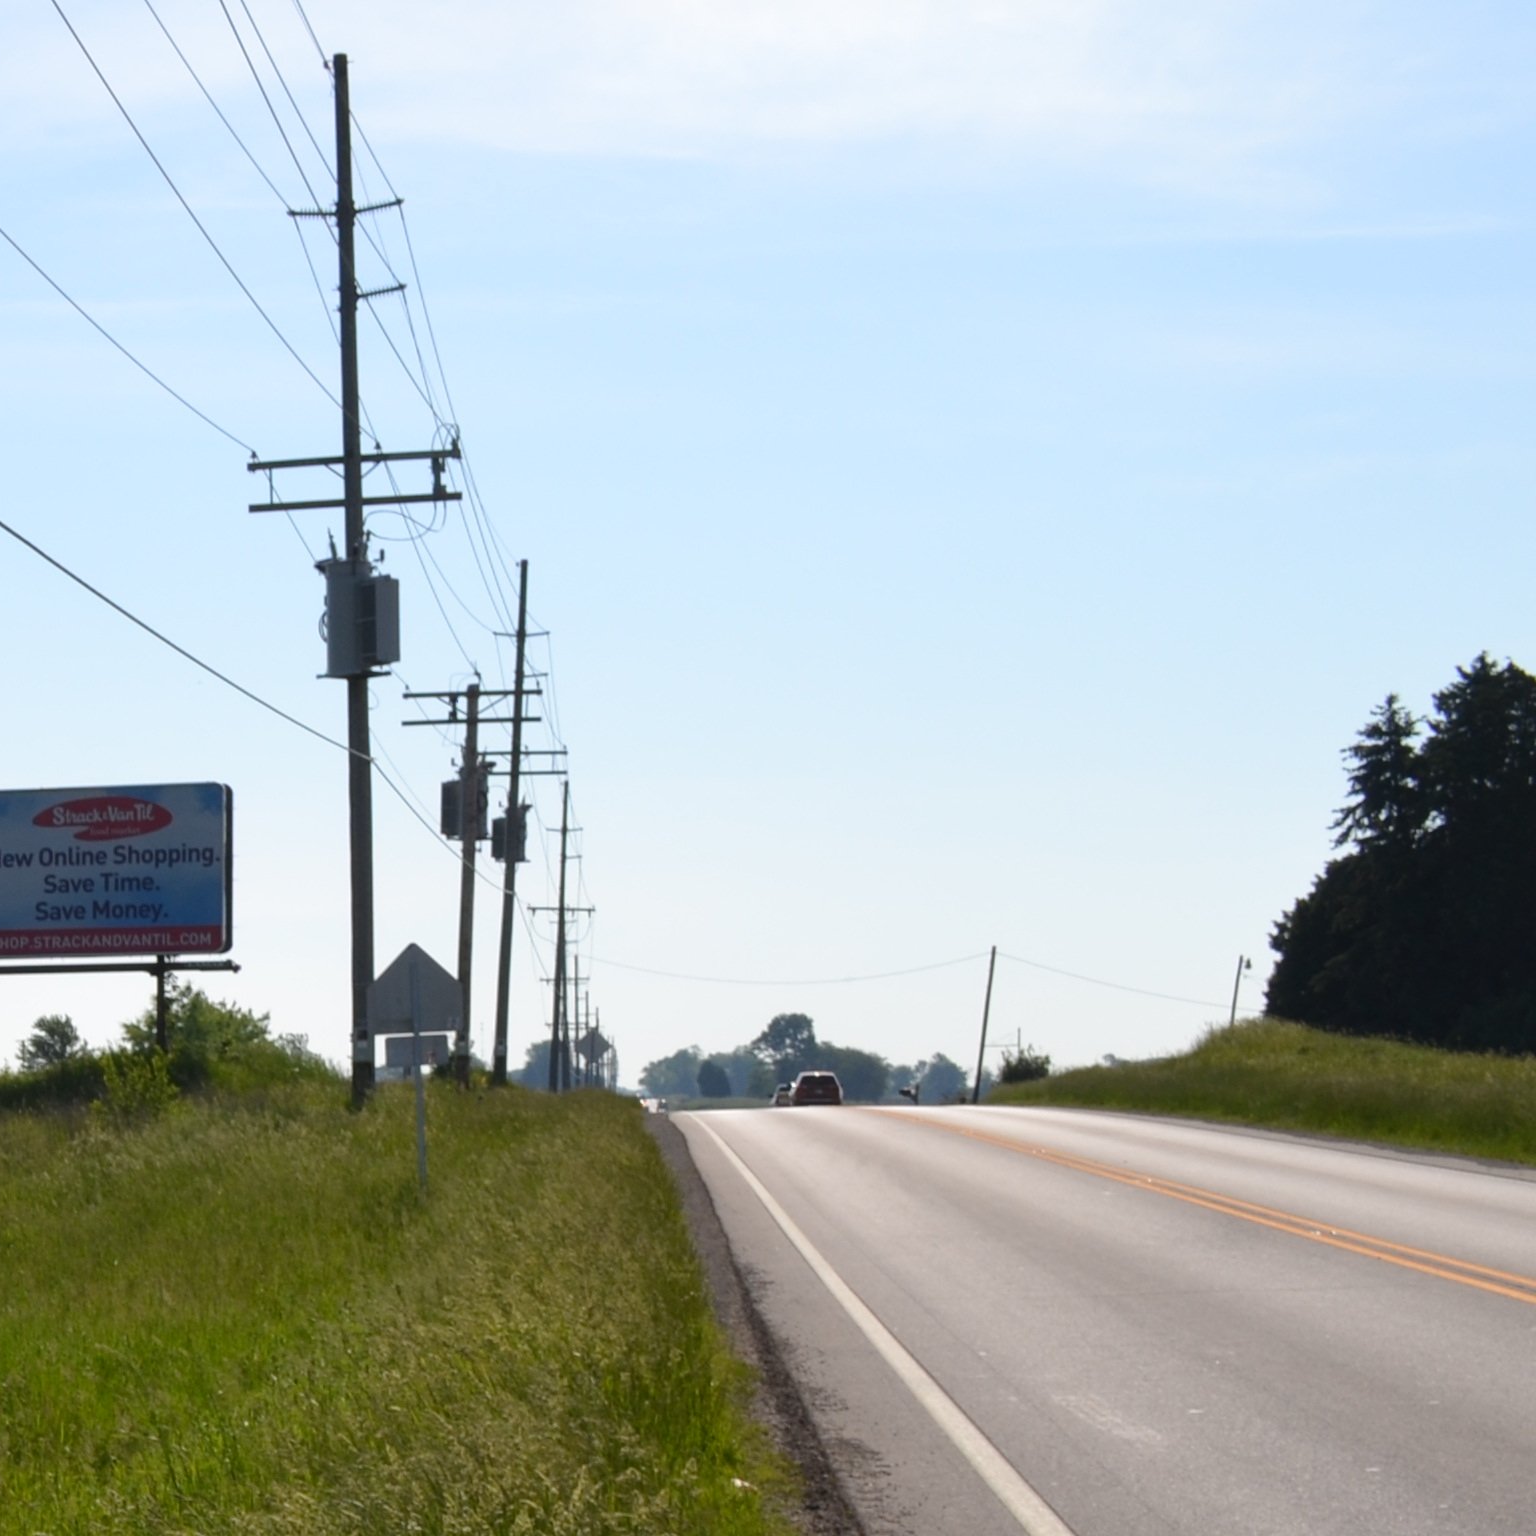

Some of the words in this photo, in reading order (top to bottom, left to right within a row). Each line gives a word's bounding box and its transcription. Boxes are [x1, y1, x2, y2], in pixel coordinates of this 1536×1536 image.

[52, 806, 102, 825] Strack
[107, 805, 134, 822] Van
[133, 803, 155, 822] Til
[39, 846, 107, 867] Online
[113, 843, 221, 868] Shopping.
[44, 874, 95, 894] Save
[101, 872, 161, 892] Time.
[35, 902, 86, 921] Save
[92, 900, 168, 922] Money.
